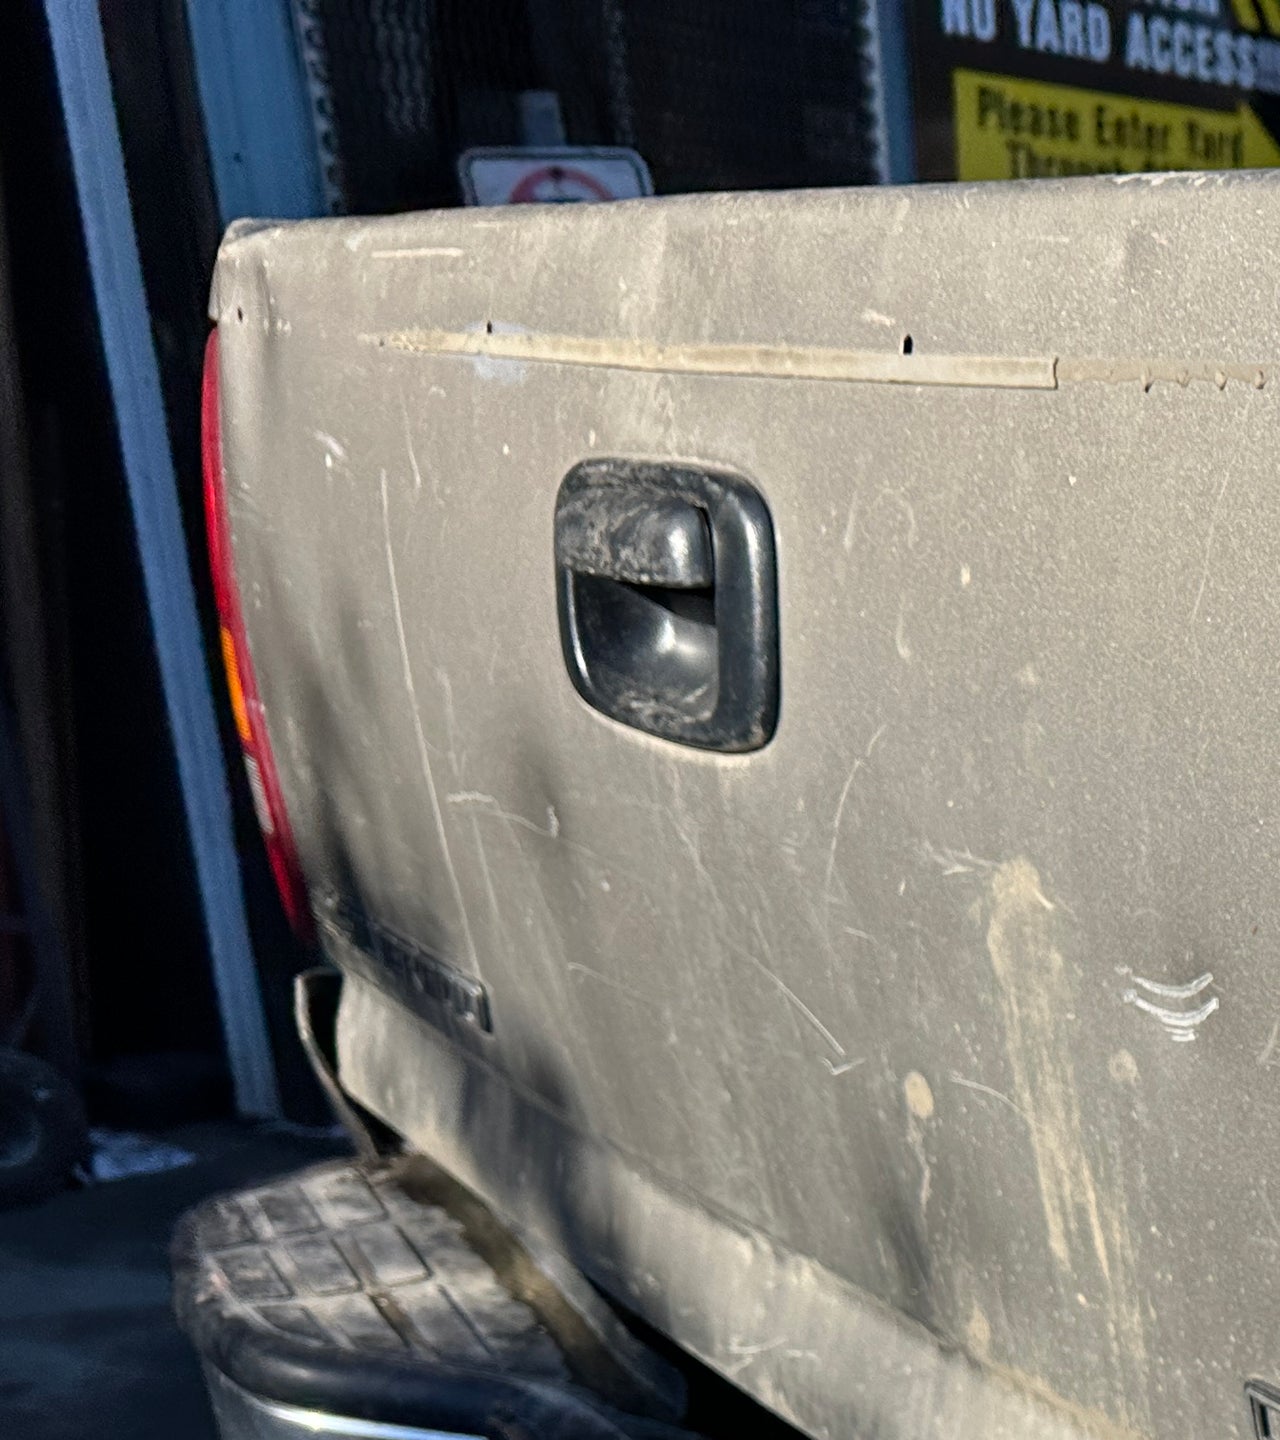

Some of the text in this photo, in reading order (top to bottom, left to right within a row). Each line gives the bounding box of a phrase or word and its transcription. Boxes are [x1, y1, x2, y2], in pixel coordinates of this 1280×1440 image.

[941, 0, 997, 43] NO
[1014, 0, 1112, 63] YARD
[977, 84, 1245, 162] Please Enter Yard
